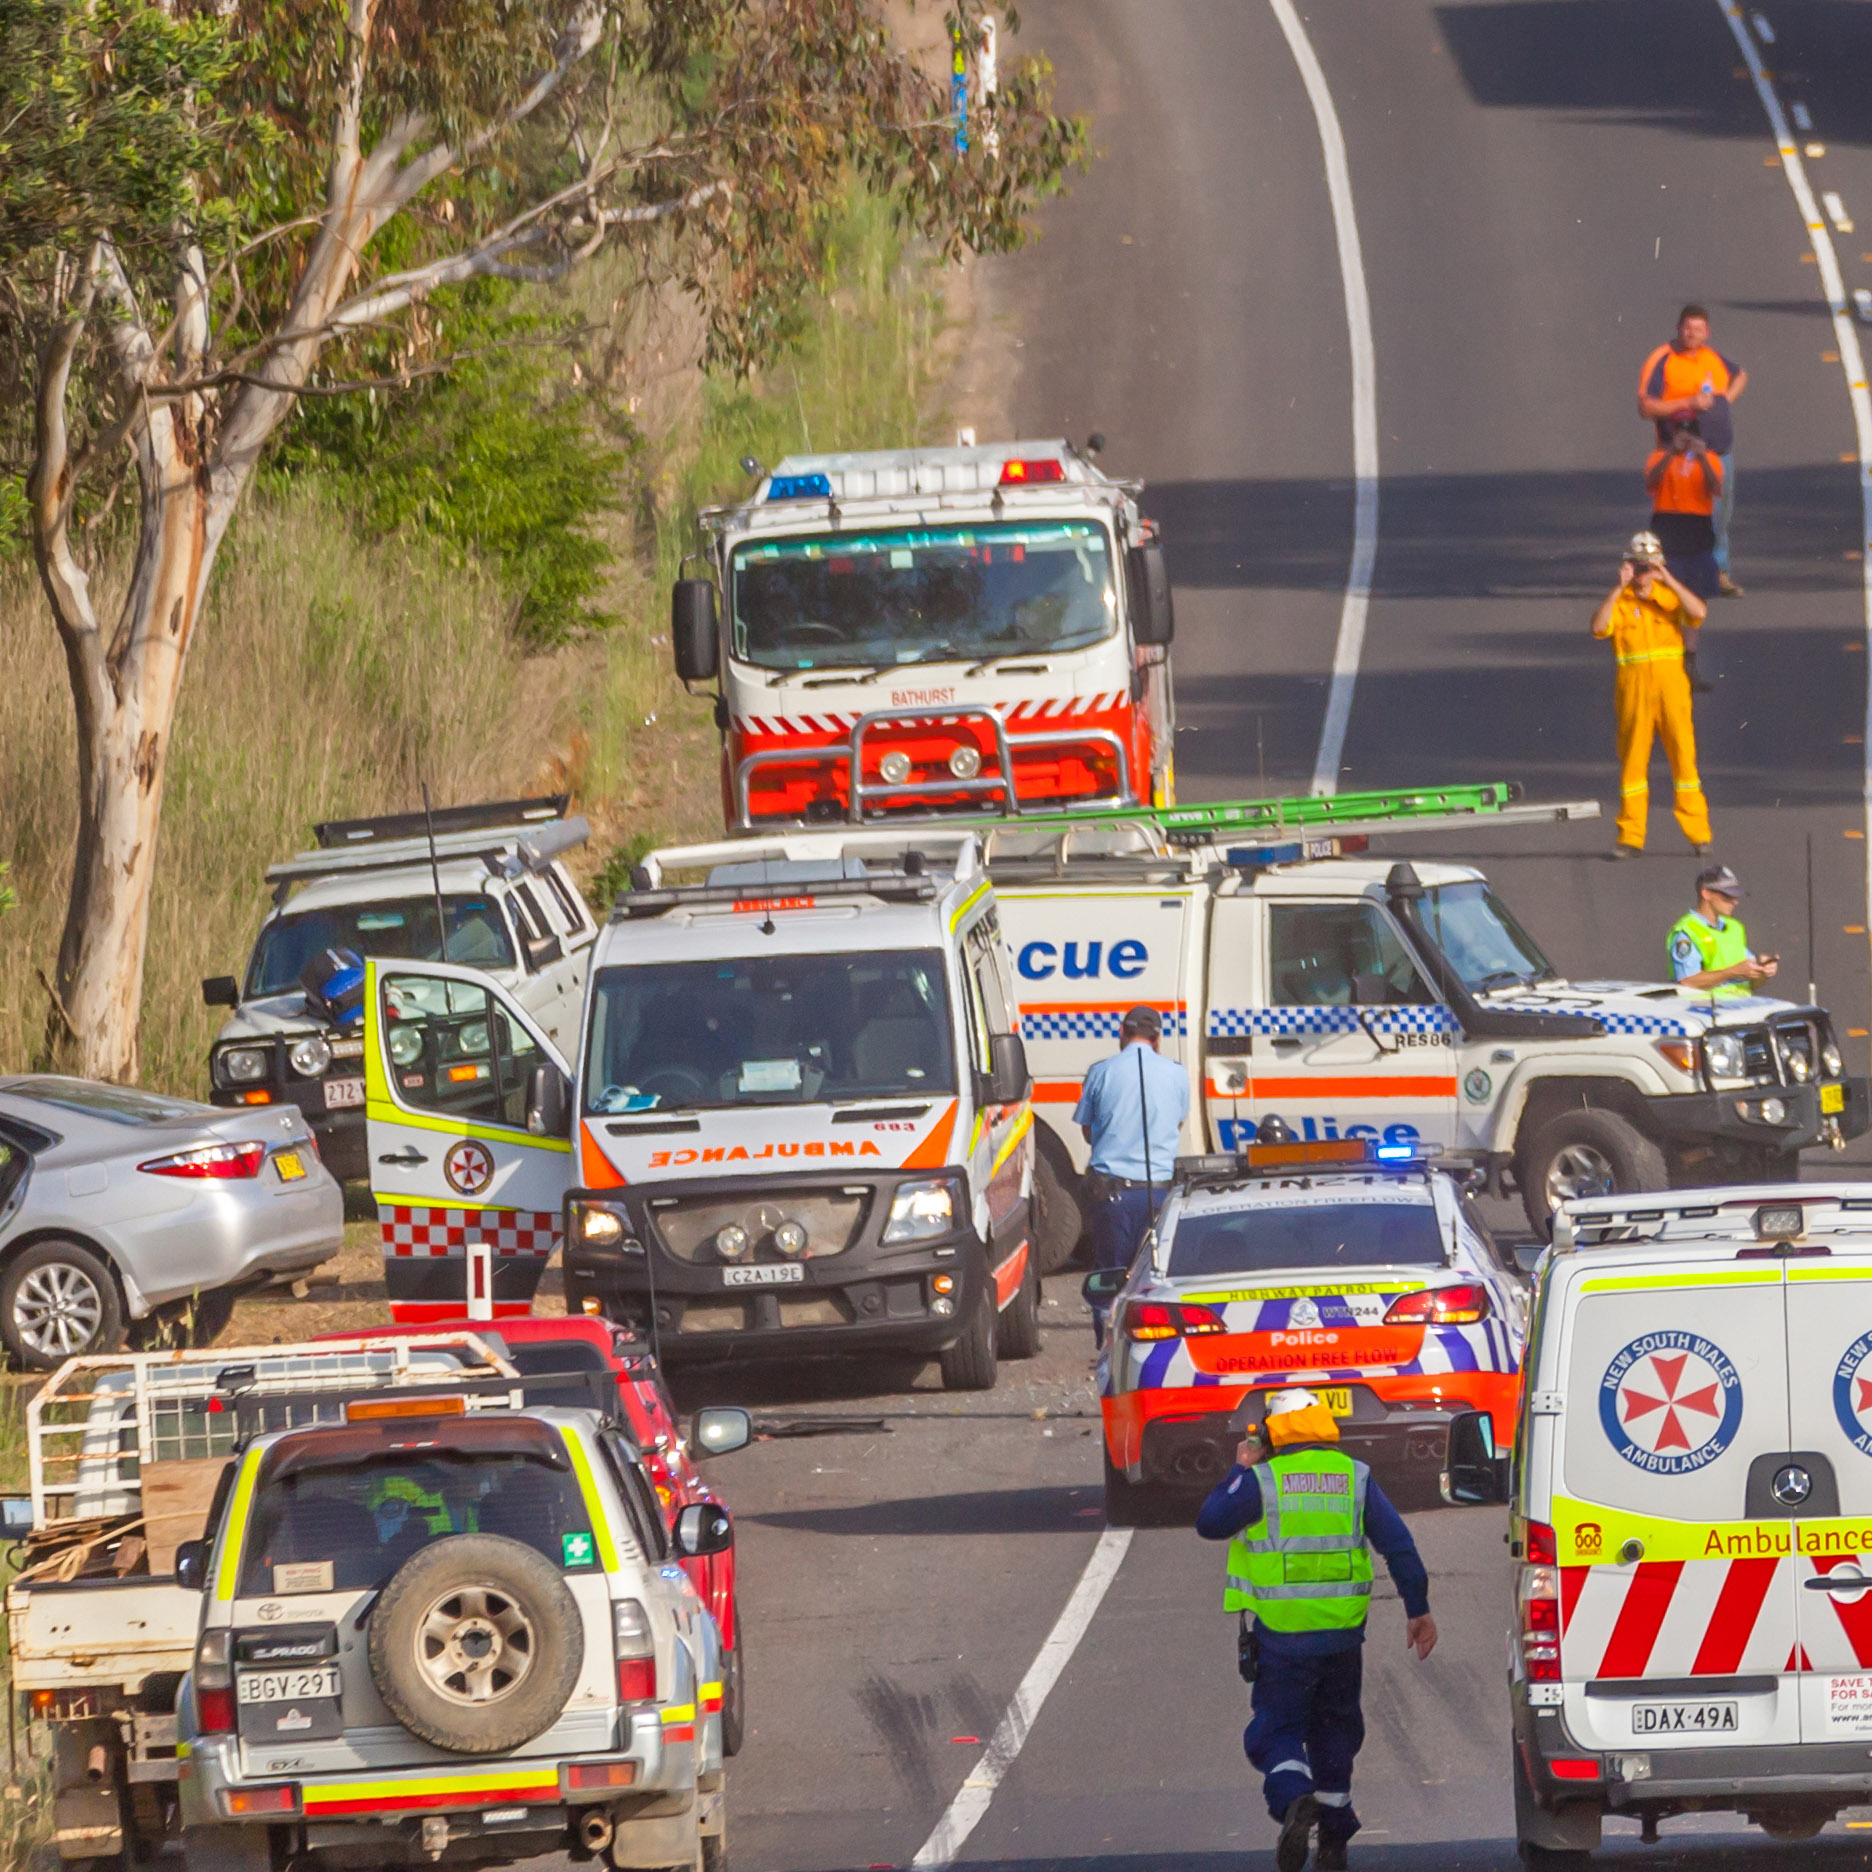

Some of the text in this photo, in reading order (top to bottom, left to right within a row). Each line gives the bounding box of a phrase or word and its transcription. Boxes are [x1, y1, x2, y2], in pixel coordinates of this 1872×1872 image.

[892, 687, 956, 706] BATHURST
[1310, 839, 1332, 858] POLICE
[1007, 939, 1149, 981] cue
[1217, 1116, 1420, 1151] Plice
[1229, 1283, 1377, 1302] HIGHWAY PATROL
[1321, 1305, 1379, 1319] WTN244
[1270, 1331, 1339, 1346] Police
[1216, 1347, 1398, 1372] OPERATION FREE FLOW
[1603, 1333, 1738, 1390] NEW SOUTH WALES
[1838, 1341, 1868, 1379] NEW
[1621, 1438, 1724, 1473] AMBULANCE
[1282, 1473, 1350, 1495] AMBULANCE
[1575, 1534, 1602, 1548] 000
[271, 1646, 317, 1658] PRADO
[1831, 1678, 1864, 1688] SAVE
[1831, 1689, 1857, 1700] FOR
[1831, 1702, 1850, 1712] For
